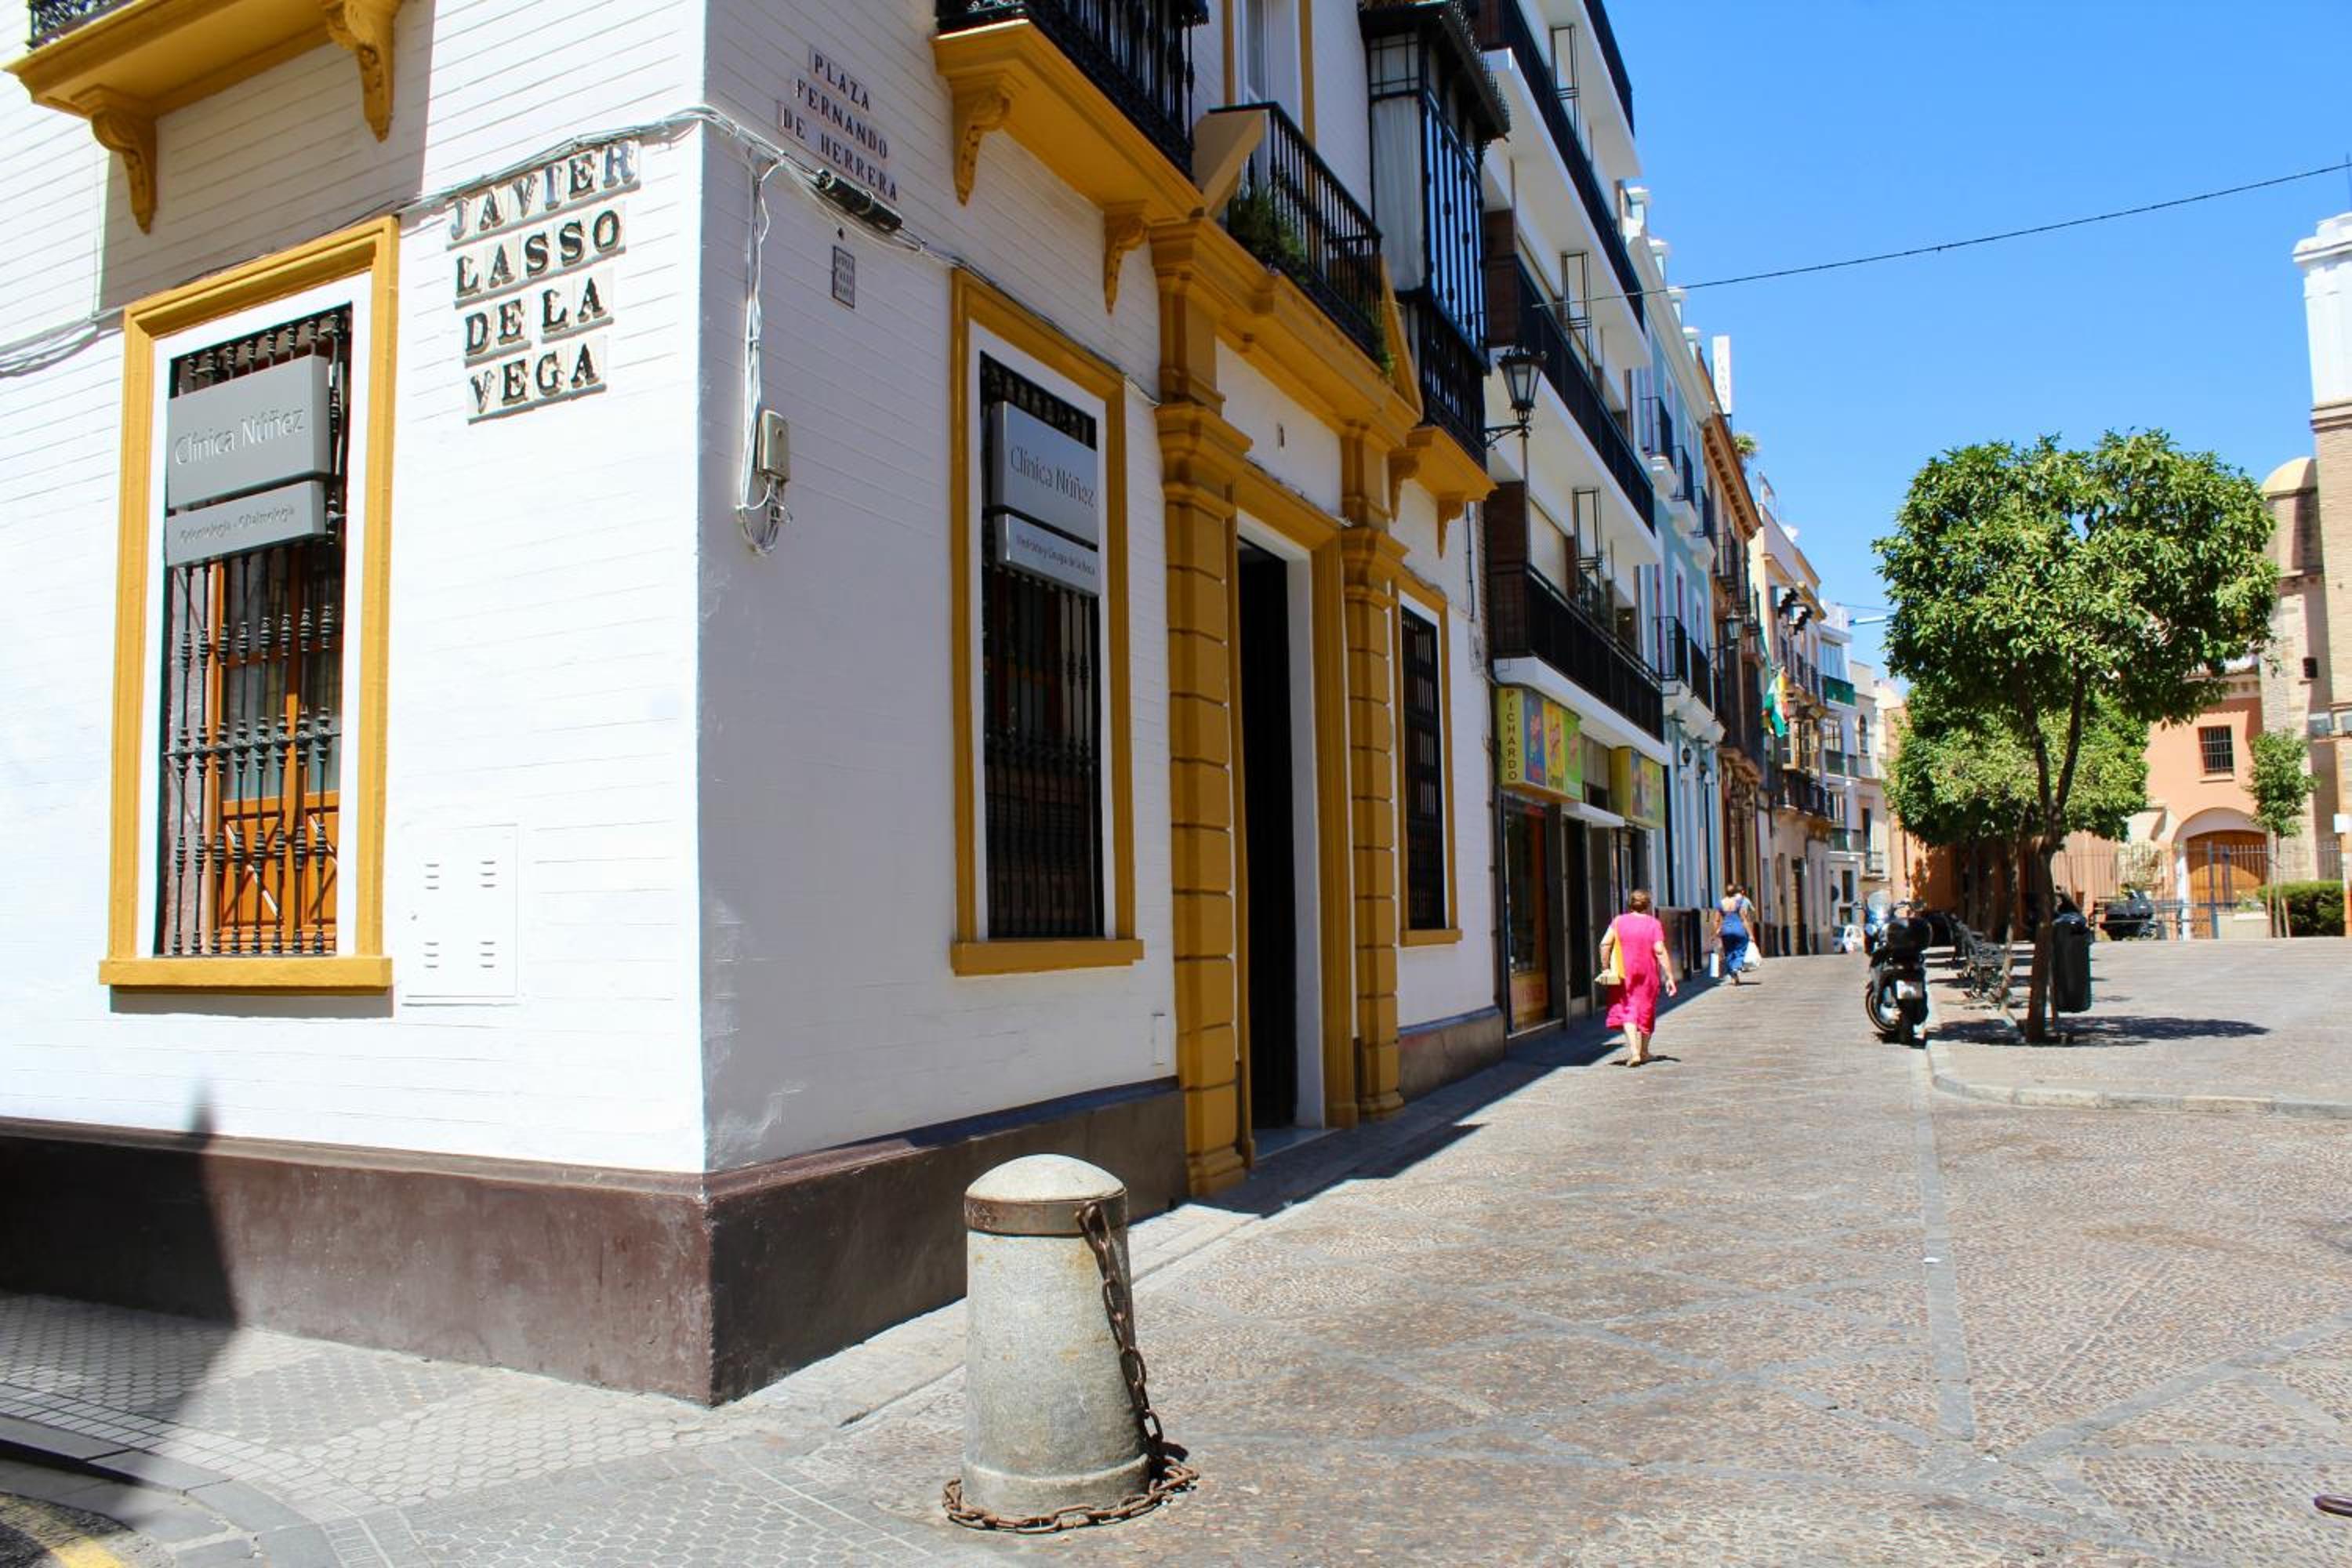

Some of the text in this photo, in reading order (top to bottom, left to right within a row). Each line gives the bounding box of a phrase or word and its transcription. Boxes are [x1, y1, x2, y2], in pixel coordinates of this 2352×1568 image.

[797, 78, 887, 159] FERNANDO
[814, 52, 869, 111] PLAZA
[451, 141, 635, 241] JAVIER
[782, 107, 898, 201] DE HERRERA
[455, 209, 621, 298] LASSO
[464, 277, 608, 357] DE LA
[470, 343, 601, 414] VEGA
[175, 408, 305, 465] Clínica Núñez
[1011, 445, 1095, 508] Clínica Núñez
[1505, 689, 1518, 781] PICHARDO
